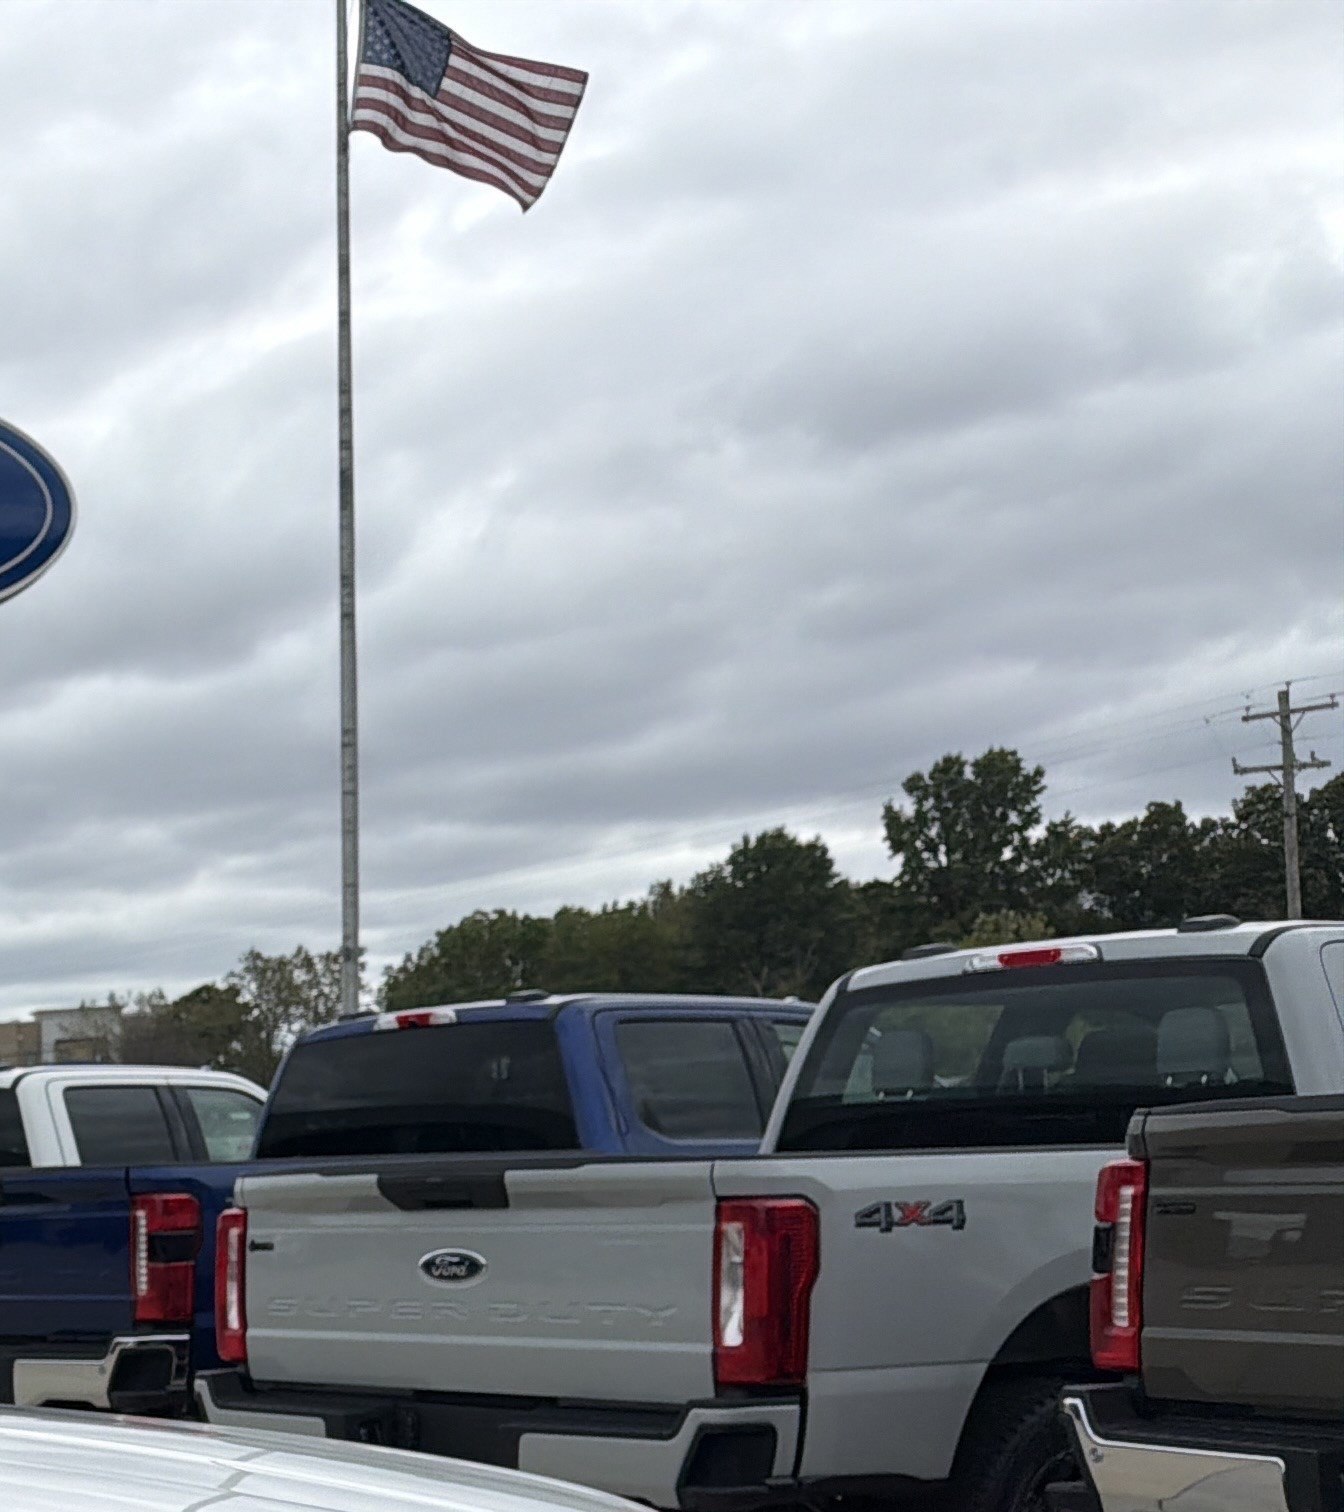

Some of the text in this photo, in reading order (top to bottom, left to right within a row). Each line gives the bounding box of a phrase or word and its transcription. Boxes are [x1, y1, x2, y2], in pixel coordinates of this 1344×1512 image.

[430, 1254, 472, 1278] Ford
[267, 1299, 679, 1328] SUPER DUTY
